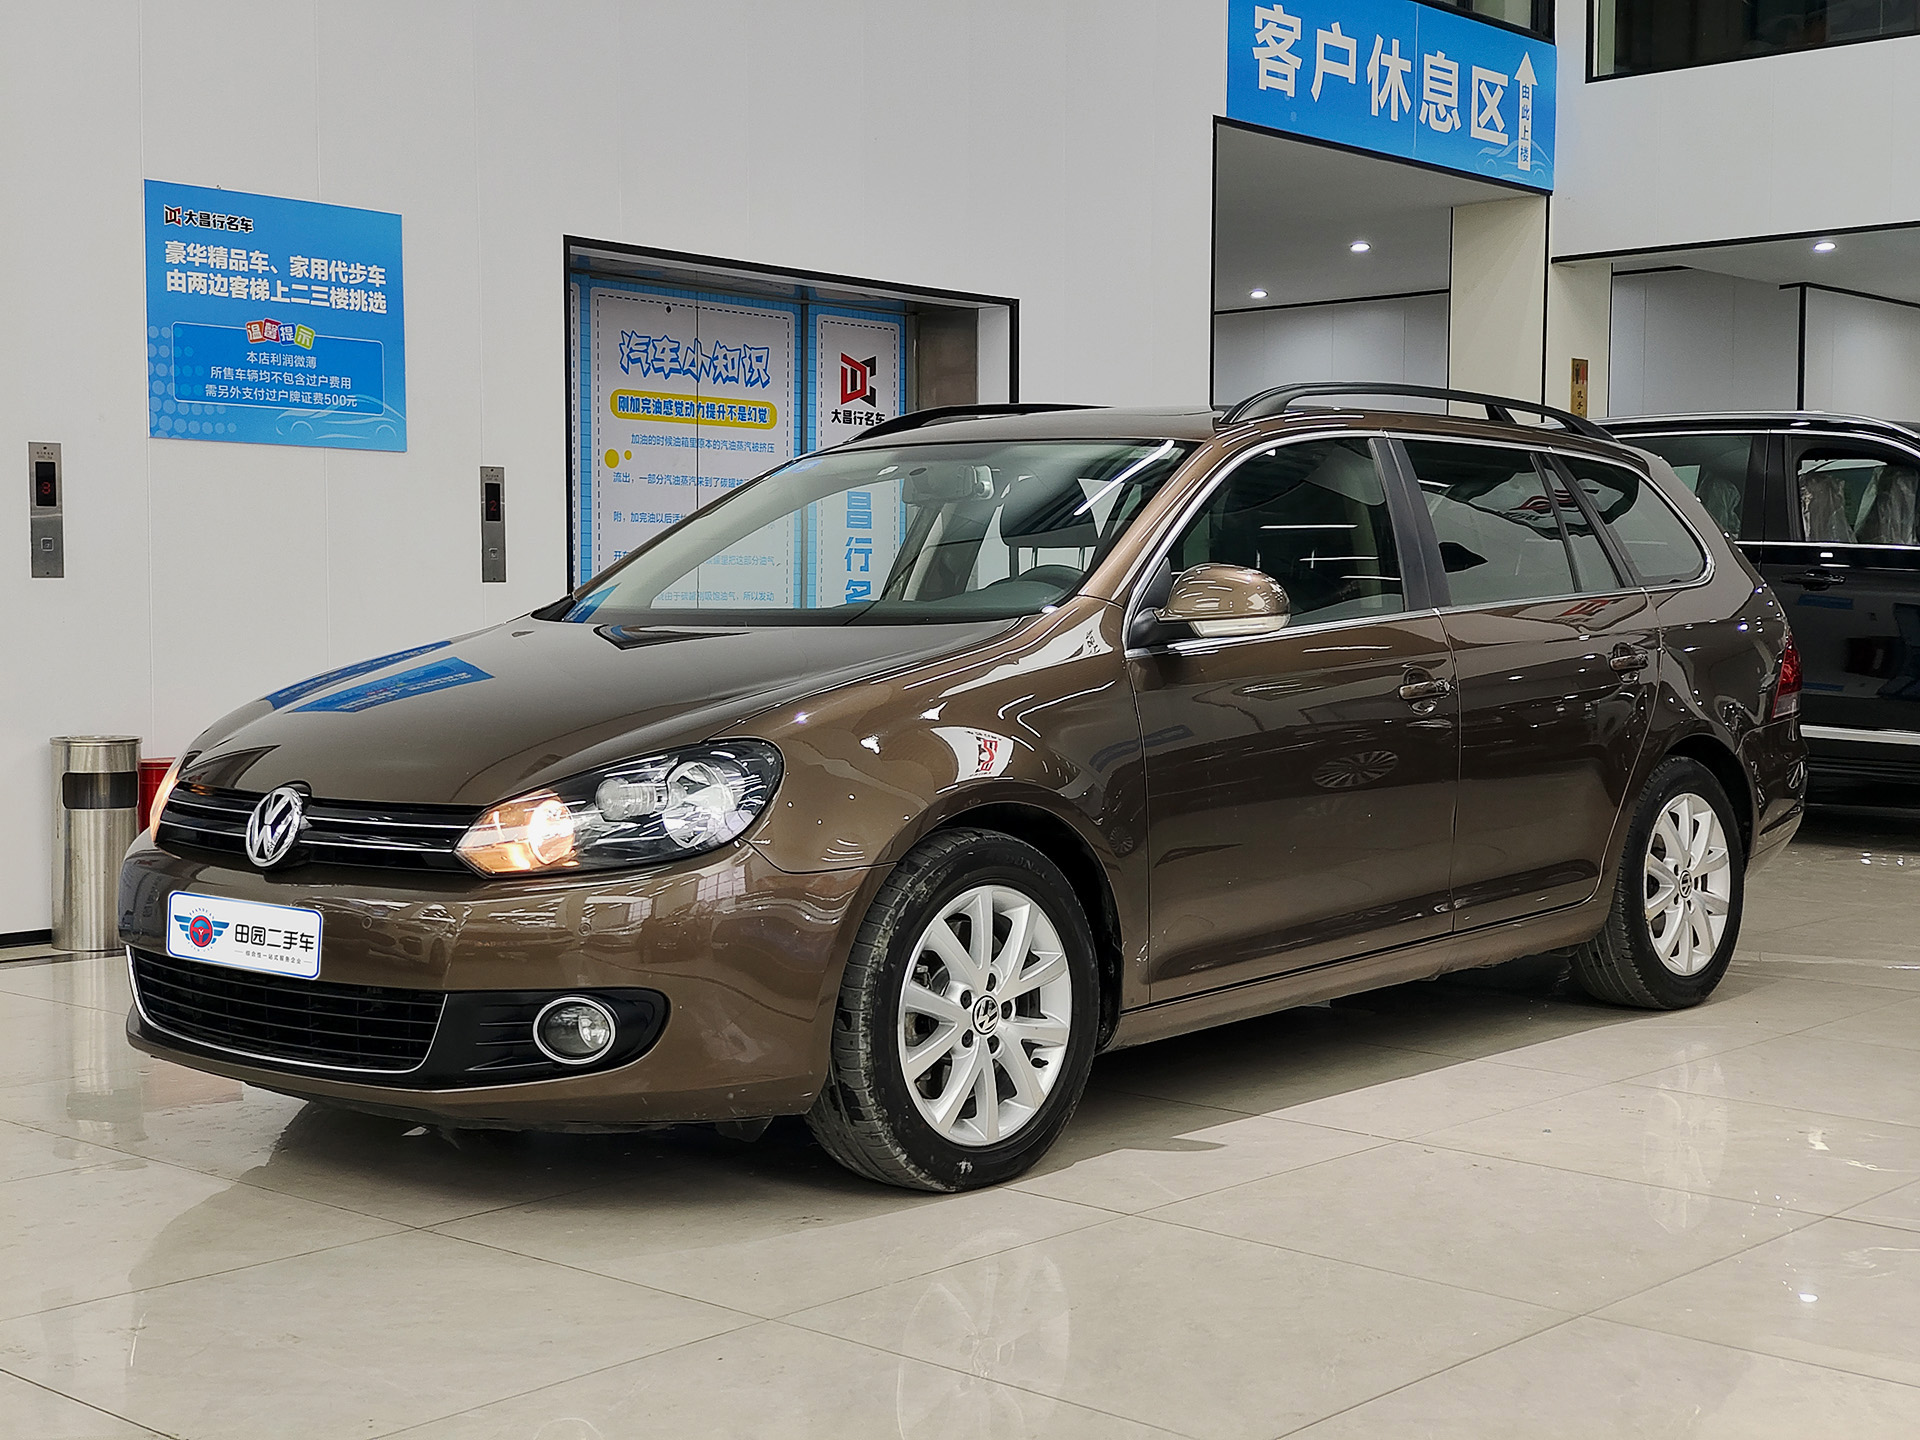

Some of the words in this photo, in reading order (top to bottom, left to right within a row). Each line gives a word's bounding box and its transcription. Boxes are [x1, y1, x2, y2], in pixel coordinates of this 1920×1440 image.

[1252, 4, 1509, 146] 客户休息区
[184, 210, 253, 232] 大昌行名车
[165, 241, 386, 287] 豪华精品车、家用代步车
[166, 270, 387, 314] 由两边客梯上二三楼挑选
[247, 320, 314, 348] 温馨提示
[246, 352, 317, 369] 本店利润微薄
[619, 330, 770, 388] 汽车小知识
[210, 367, 351, 389] 所售车辆均不包含过户费用
[205, 385, 357, 407] 需另外支付过户牌证费500元
[831, 409, 885, 426] 大昌行名车
[235, 924, 315, 952] 田园二手车
